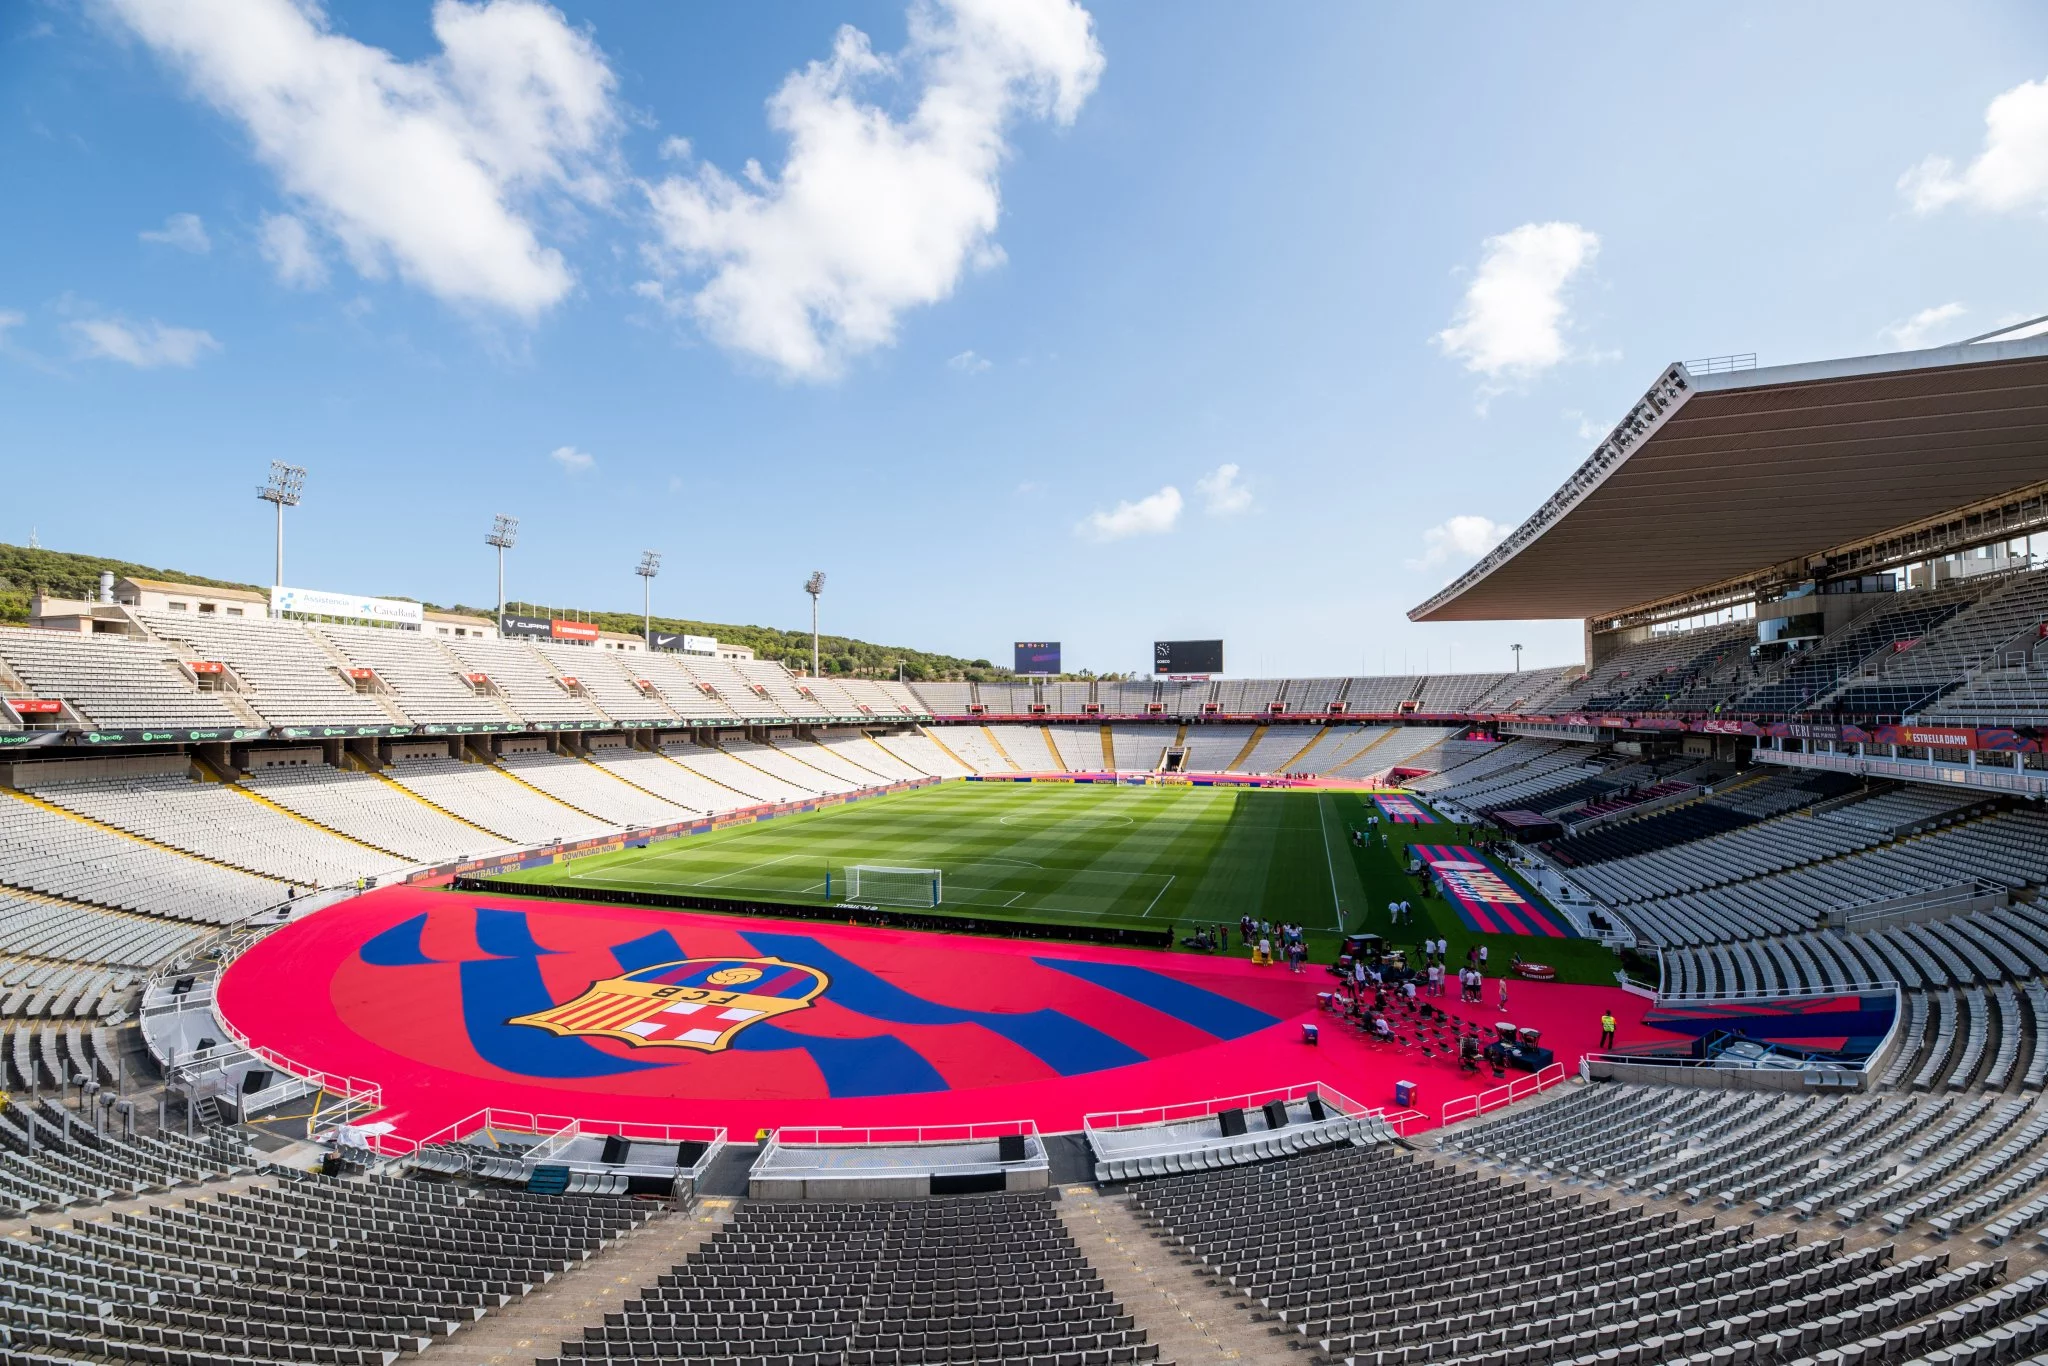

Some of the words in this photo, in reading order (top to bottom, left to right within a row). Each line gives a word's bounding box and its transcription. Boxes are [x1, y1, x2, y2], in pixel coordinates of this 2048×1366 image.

[374, 605, 418, 619] CaixaBank
[517, 622, 550, 630] CUPRA
[1790, 724, 1810, 737] VERI
[1913, 733, 1944, 744] ESTRELLA
[1945, 734, 1967, 746] DAMM
[562, 848, 600, 861] DOWNLOAD
[601, 844, 617, 853] NOW
[502, 863, 520, 873] 2023
[650, 987, 741, 1006] FCB
